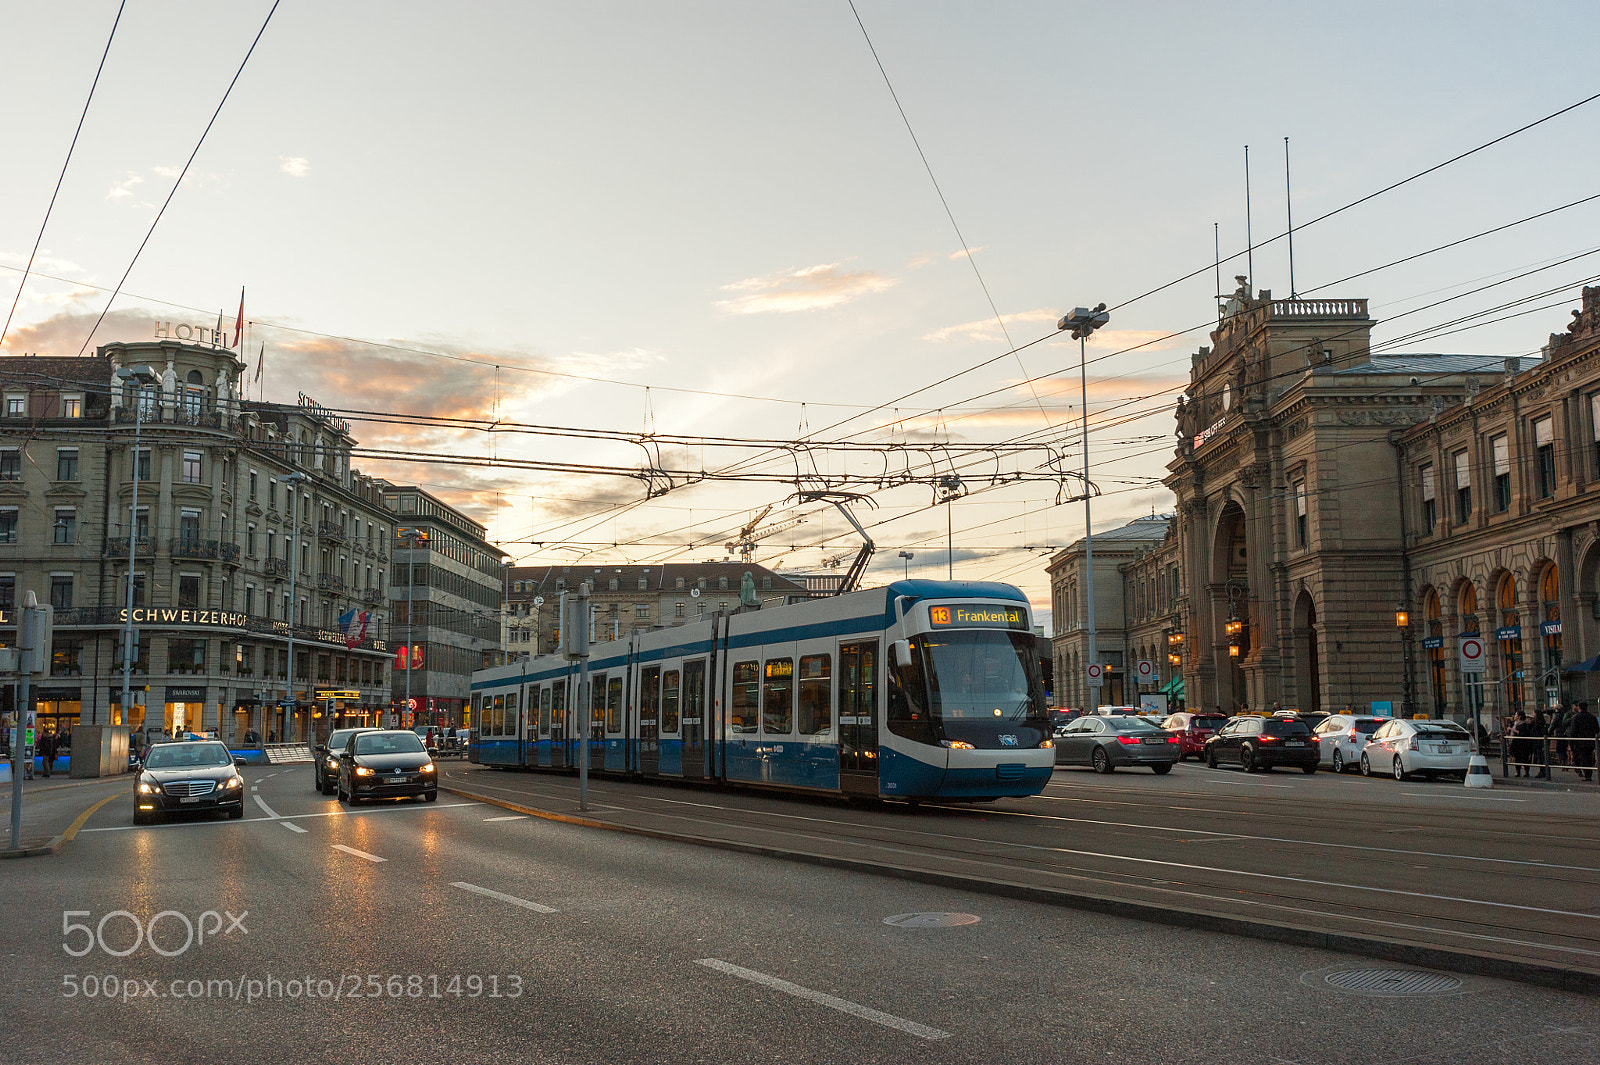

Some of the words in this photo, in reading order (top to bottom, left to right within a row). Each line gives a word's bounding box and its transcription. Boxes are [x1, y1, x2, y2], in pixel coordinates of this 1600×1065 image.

[154, 320, 229, 350] HOTEL
[119, 608, 247, 627] SCHWEIZERHOF
[933, 609, 949, 622] 13
[957, 609, 1020, 623] Frankental
